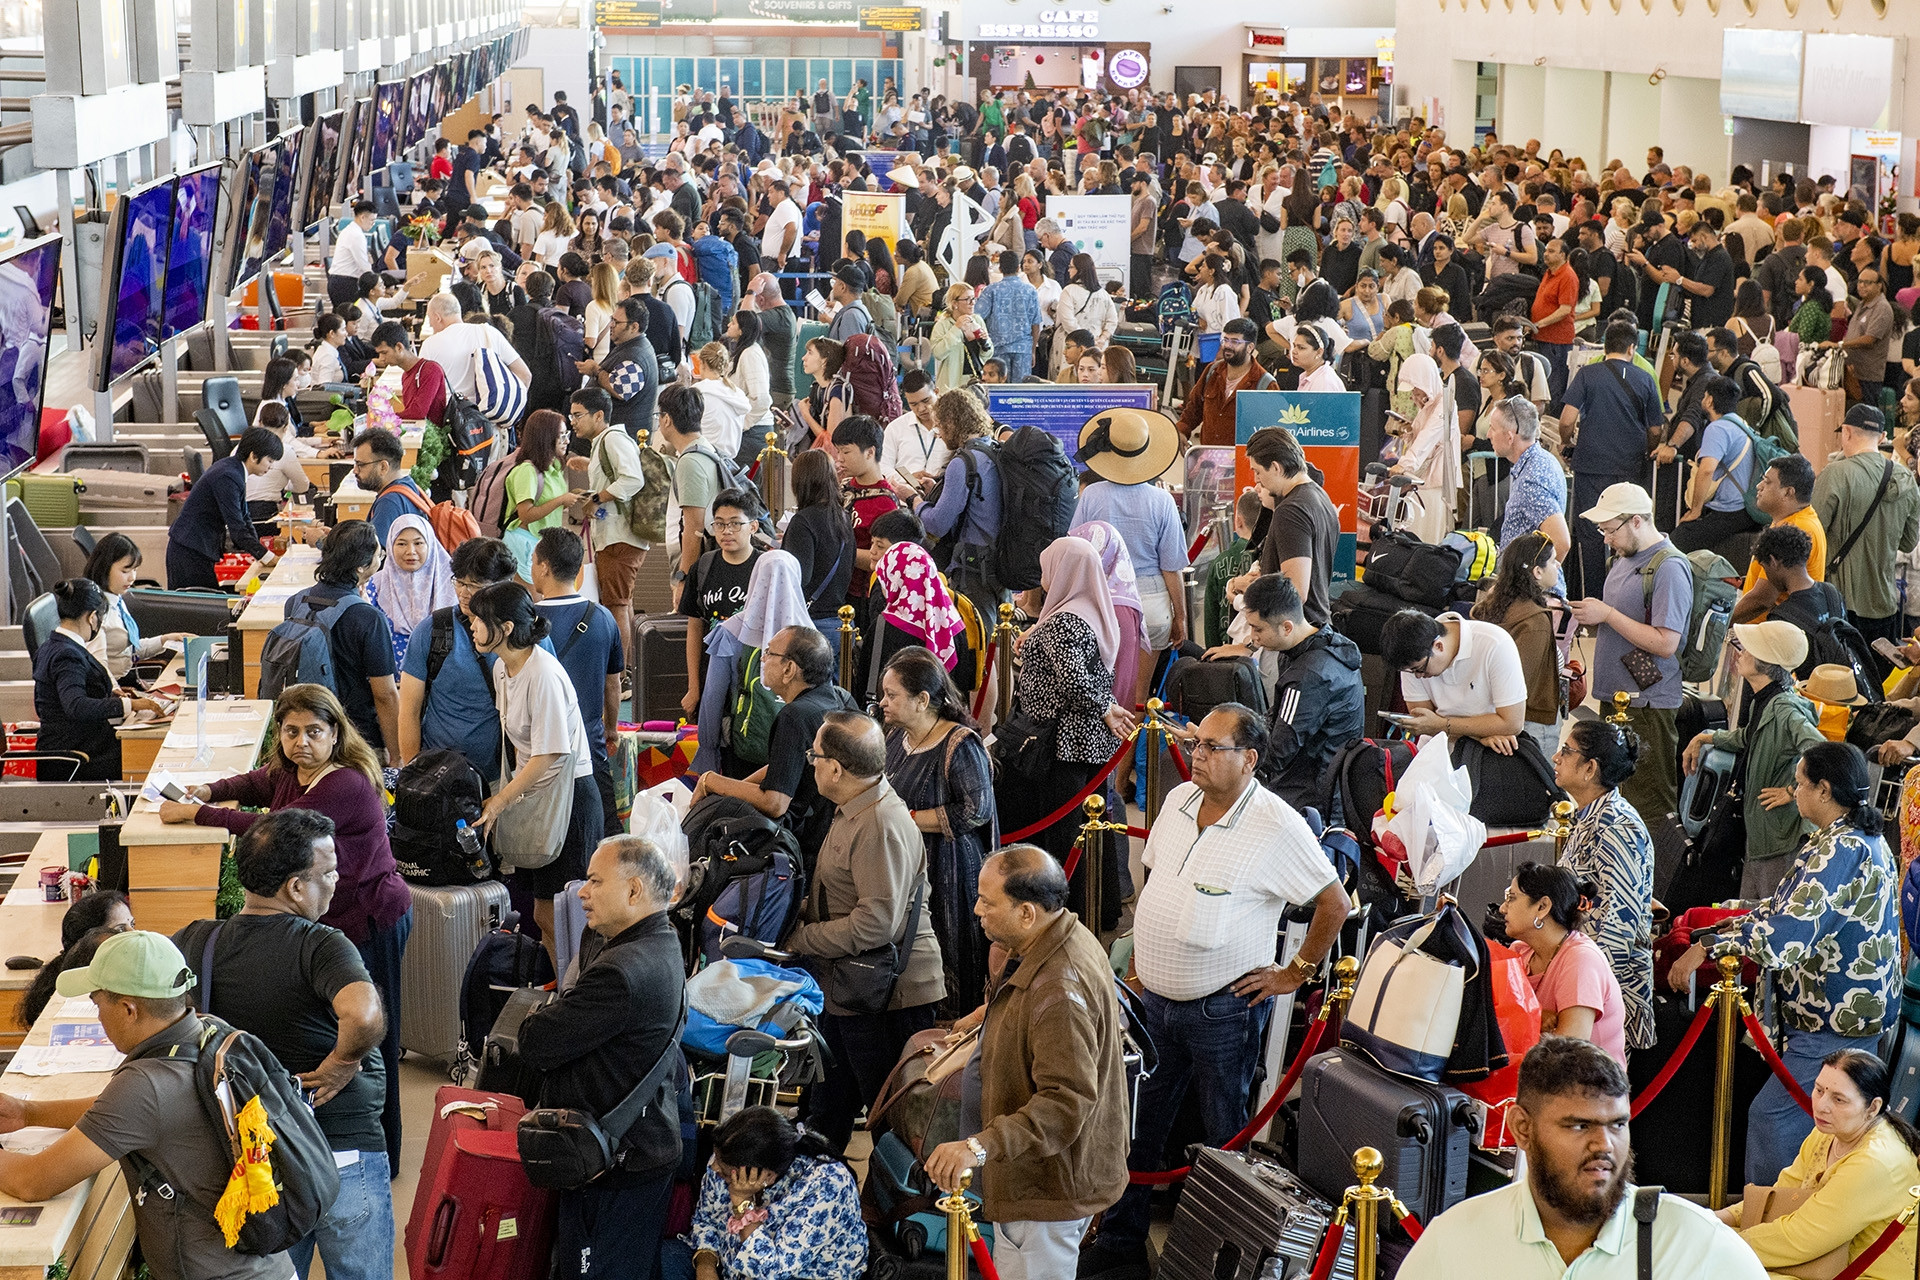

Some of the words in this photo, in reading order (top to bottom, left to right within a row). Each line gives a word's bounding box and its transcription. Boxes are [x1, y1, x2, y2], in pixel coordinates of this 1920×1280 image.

[764, 0, 816, 10] SOUVENIRS
[817, 1, 826, 10] &
[827, 1, 853, 10] GIFTS
[1039, 9, 1099, 23] CAFE
[978, 23, 1099, 38] ESPRESSO
[1117, 51, 1141, 60] CAFE
[1111, 69, 1147, 87] ESPRESSO
[1296, 426, 1334, 438] Airlines
